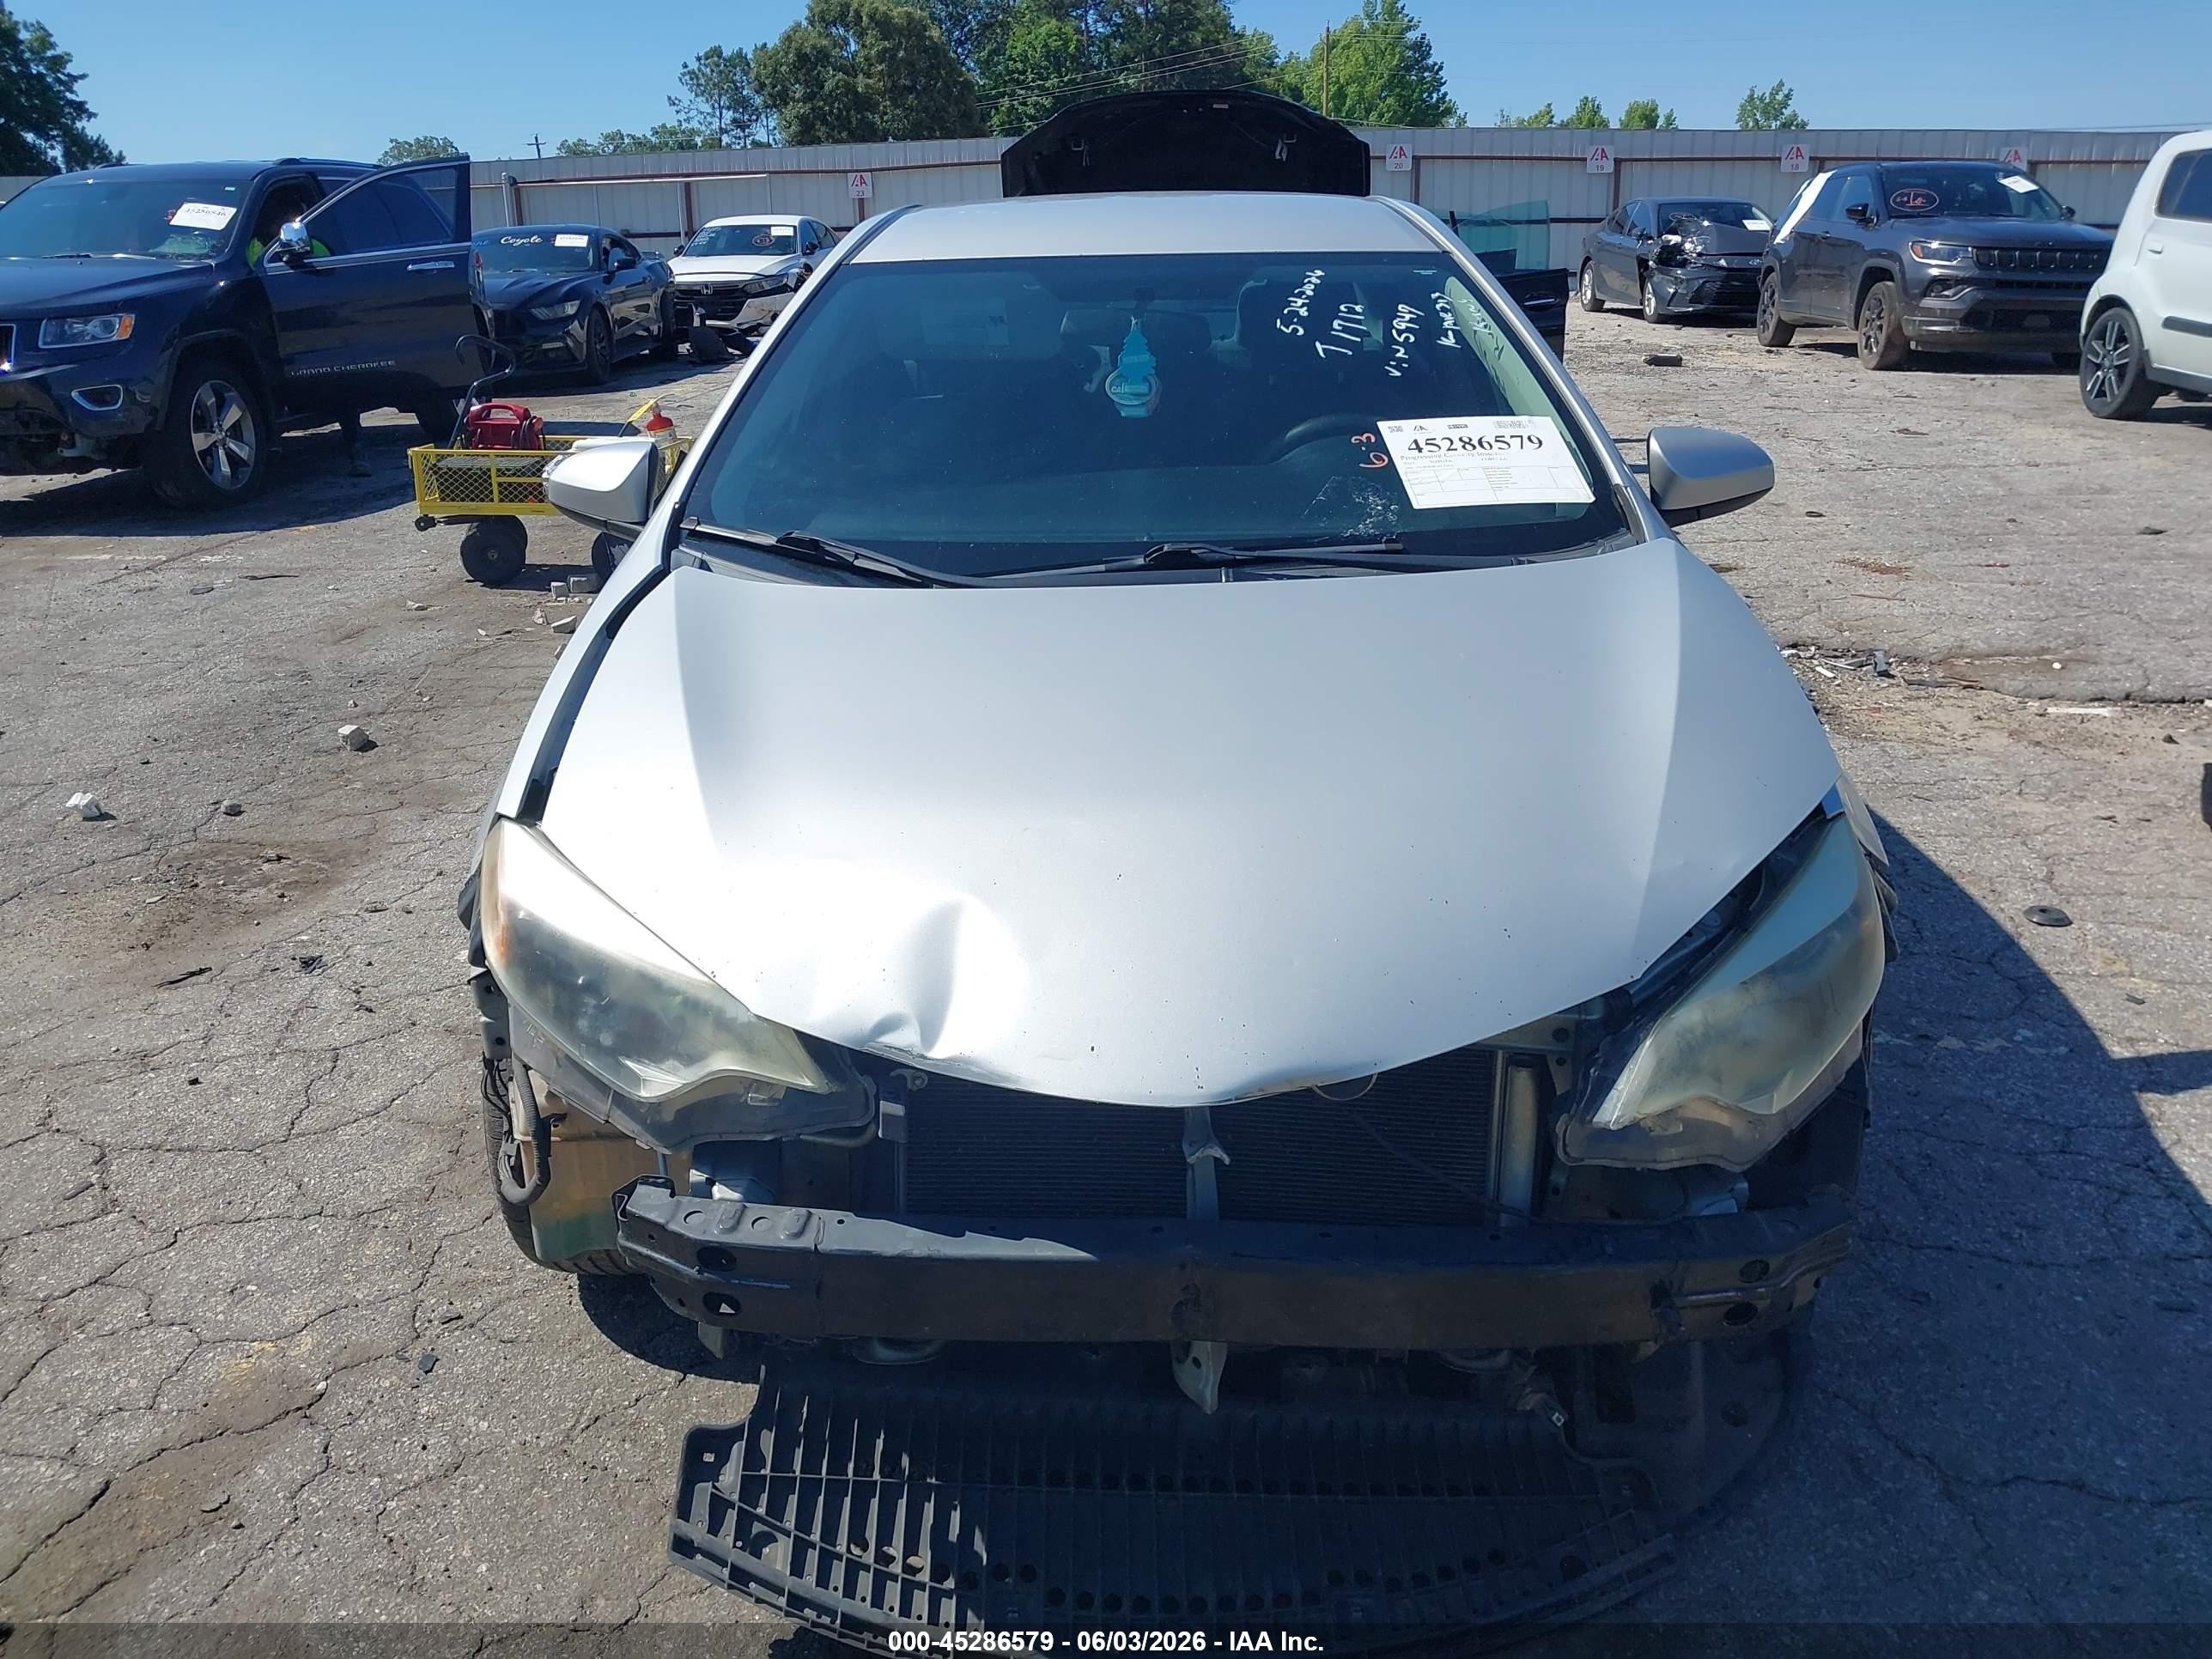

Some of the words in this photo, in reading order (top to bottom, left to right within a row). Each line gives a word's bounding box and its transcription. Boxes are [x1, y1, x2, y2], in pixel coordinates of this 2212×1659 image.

[501, 235, 543, 246] Coyote
[333, 360, 395, 372] CHEROKEE
[1407, 434, 1543, 454] 45286579
